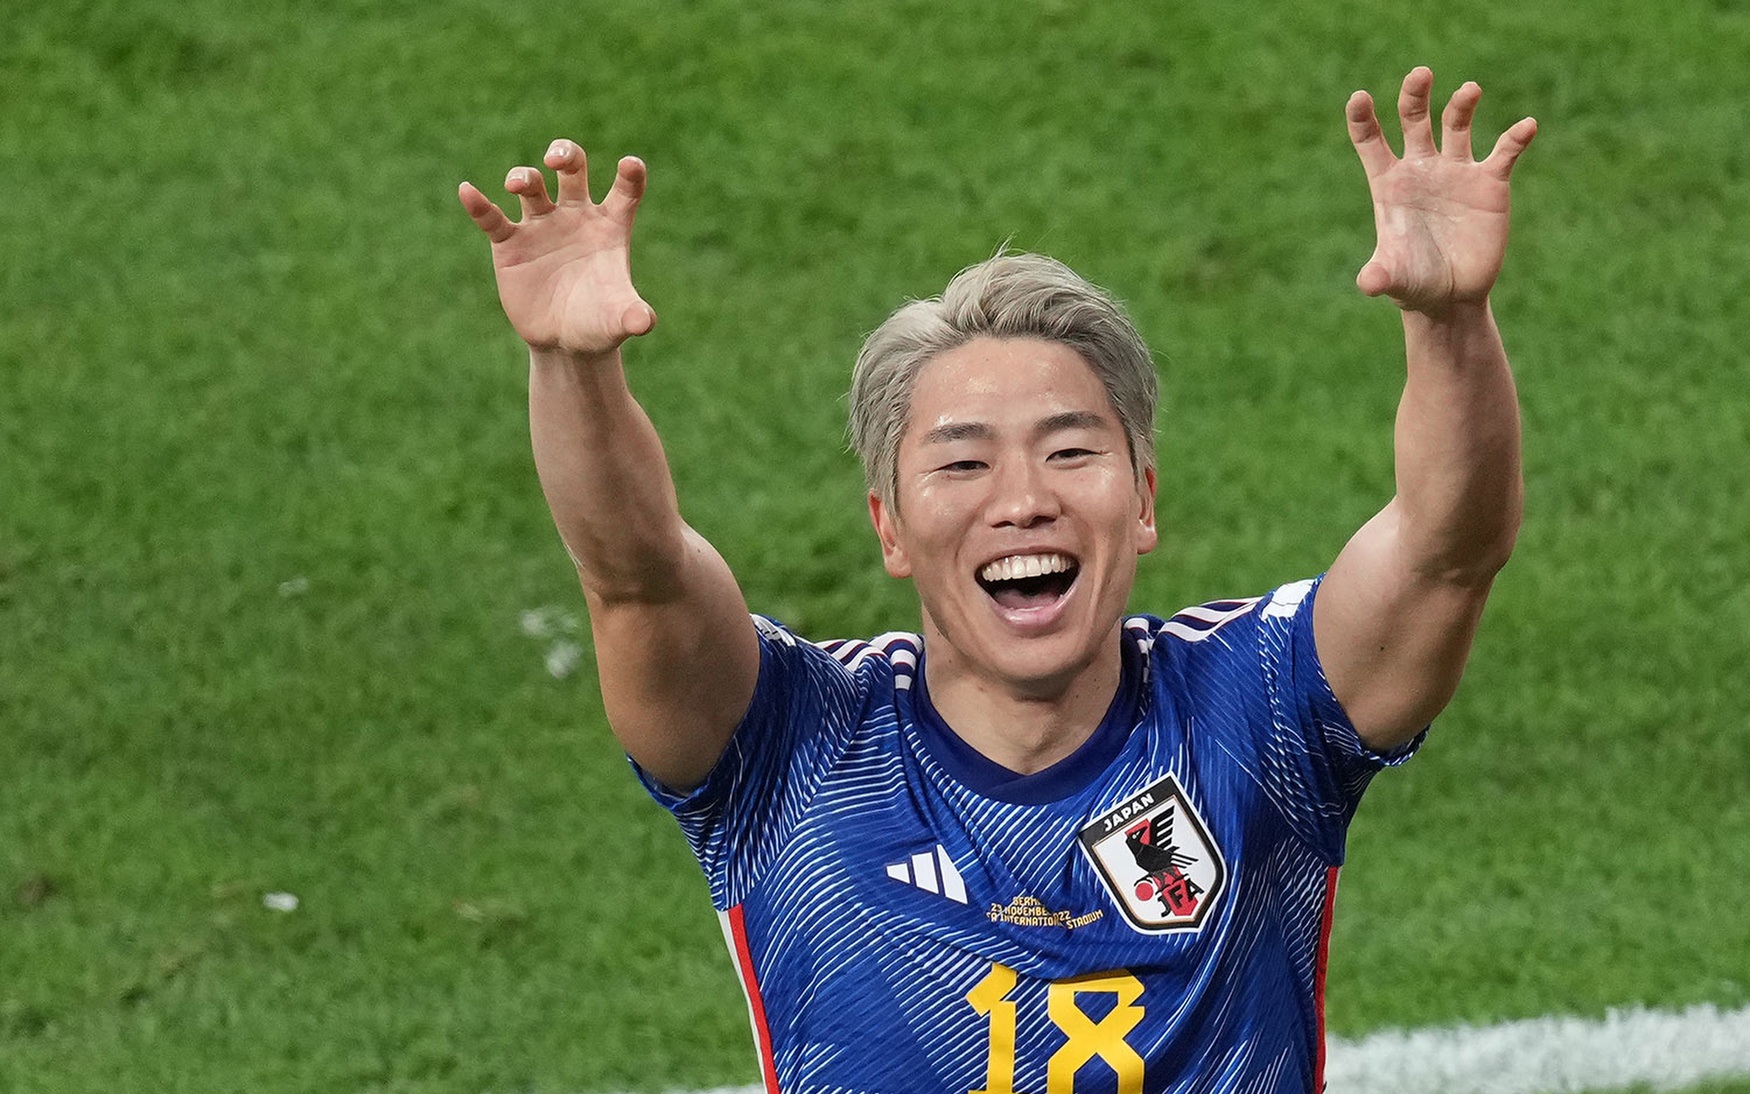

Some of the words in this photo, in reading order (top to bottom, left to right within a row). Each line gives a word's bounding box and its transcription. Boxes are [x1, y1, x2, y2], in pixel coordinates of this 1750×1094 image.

[1103, 793, 1154, 832] JAPAN
[1012, 896, 1042, 906] GERM
[1157, 878, 1205, 917] JFA
[1004, 905, 1050, 916] NOVEMBE
[1066, 909, 1104, 929] STADIUM
